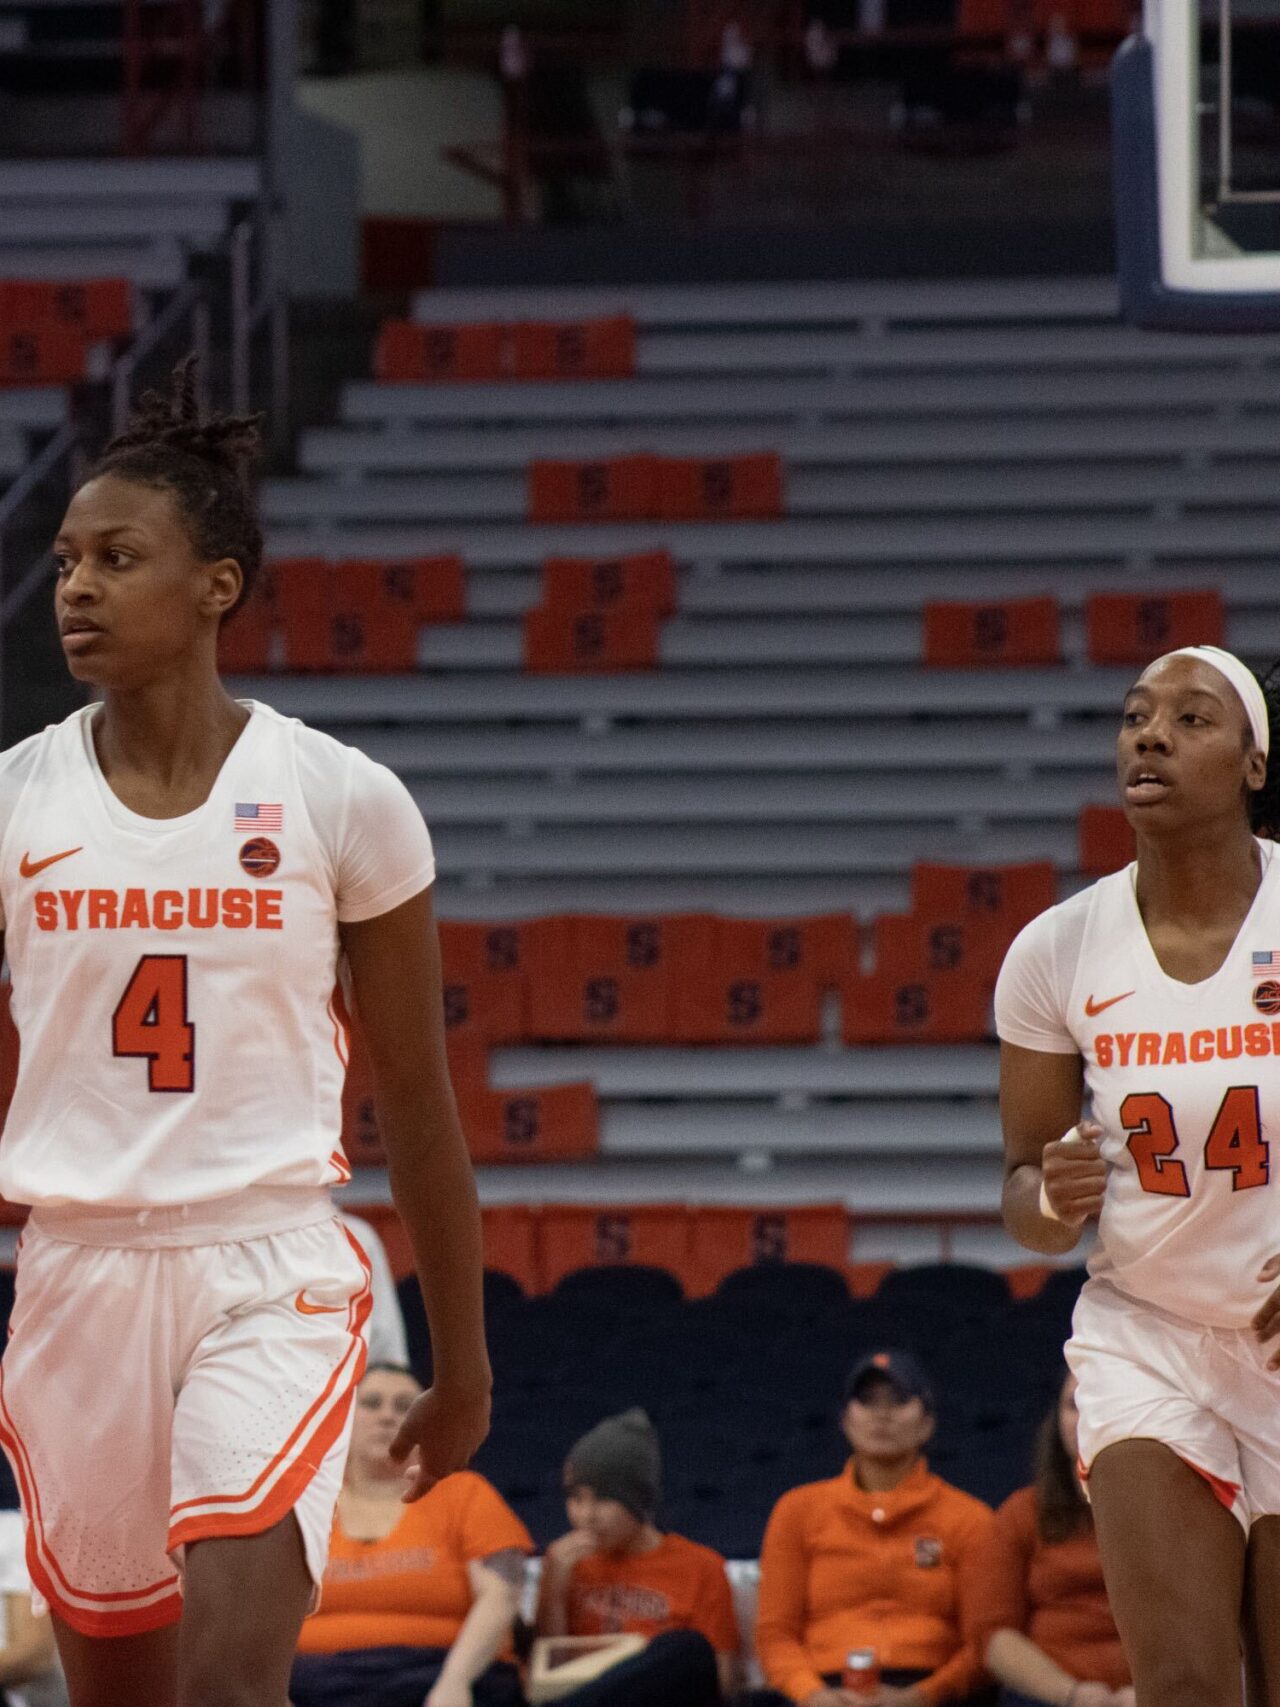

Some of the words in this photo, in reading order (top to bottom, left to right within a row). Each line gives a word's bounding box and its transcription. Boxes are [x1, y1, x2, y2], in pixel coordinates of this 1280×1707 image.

[34, 888, 283, 931] SYRACUSE
[627, 922, 660, 967] S
[111, 954, 195, 1093] 4
[585, 978, 618, 1024] S
[728, 982, 762, 1027] S
[505, 1096, 539, 1145] S
[1119, 1085, 1270, 1198] 24
[595, 1214, 630, 1260] S
[752, 1214, 790, 1264] S
